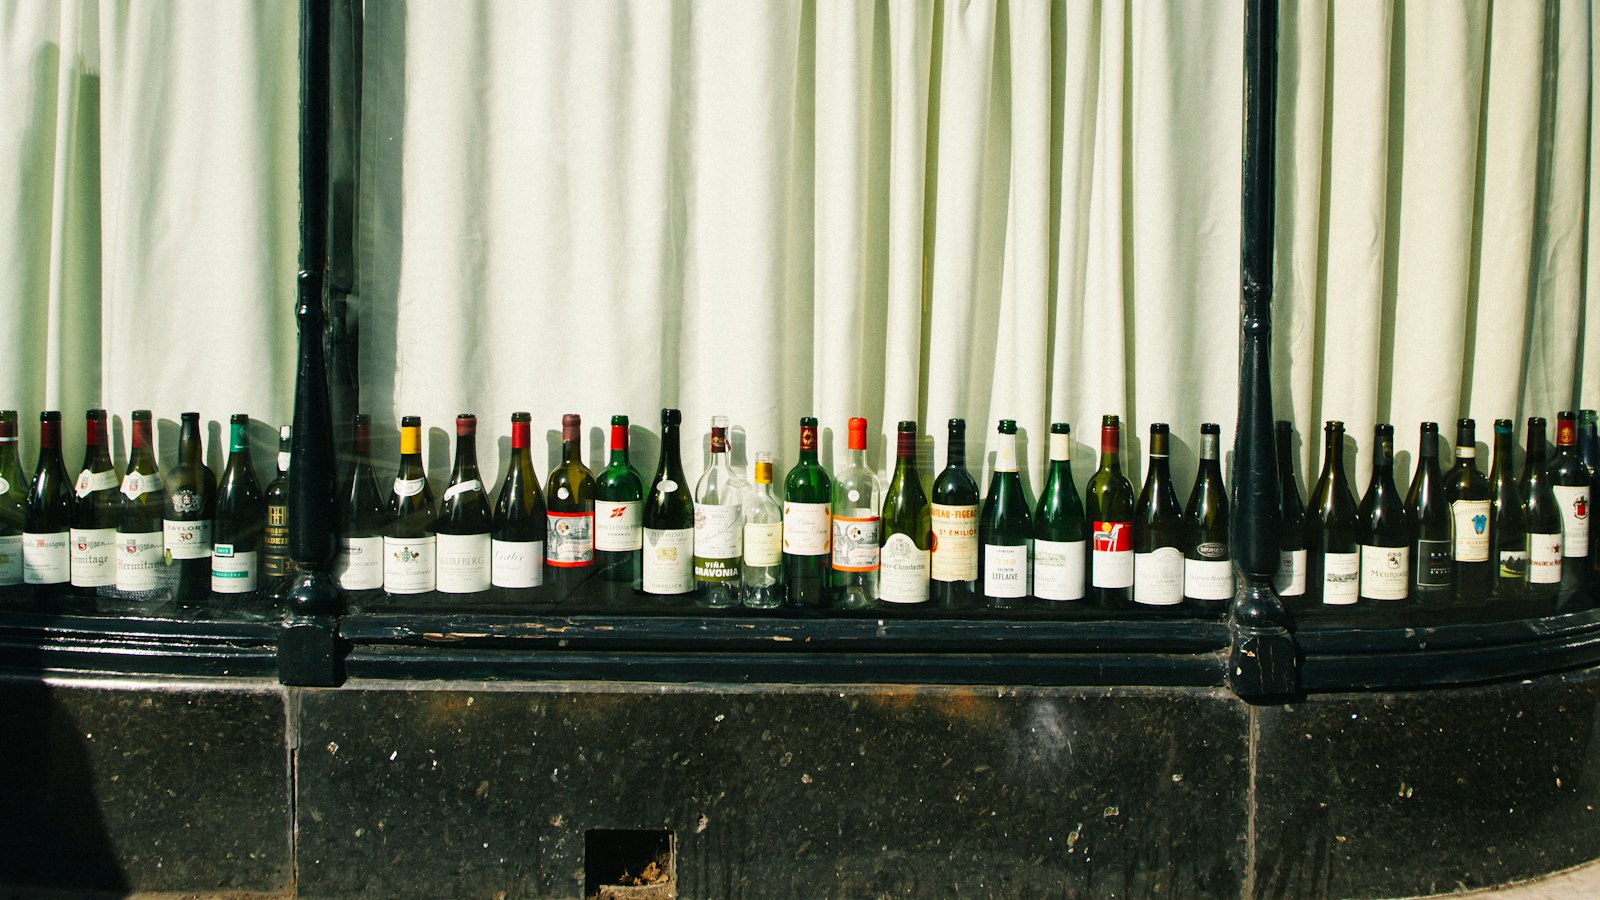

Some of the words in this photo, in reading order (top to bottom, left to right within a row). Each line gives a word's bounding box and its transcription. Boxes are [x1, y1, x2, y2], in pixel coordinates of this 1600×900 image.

[178, 532, 194, 542] 30
[705, 561, 725, 569] VIÑA
[695, 566, 738, 578] GRAVONIA
[992, 572, 1018, 581] LEFLAIVE
